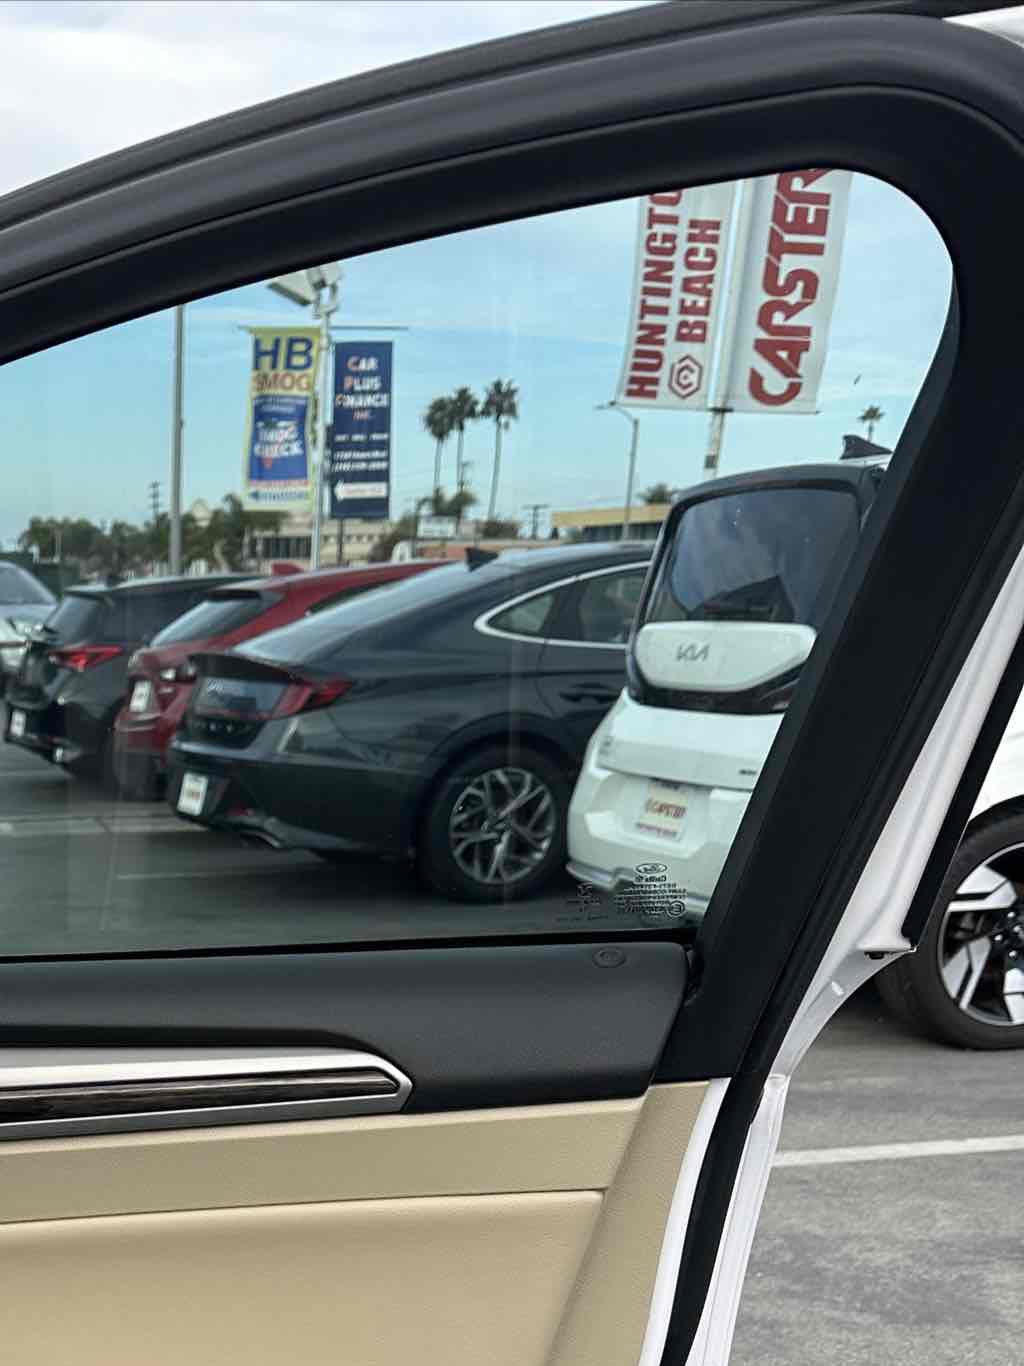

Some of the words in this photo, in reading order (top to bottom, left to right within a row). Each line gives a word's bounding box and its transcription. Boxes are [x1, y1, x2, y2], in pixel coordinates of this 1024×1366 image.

[624, 188, 683, 399] HUNTINGTO
[676, 218, 722, 344] BEACH
[254, 336, 313, 371] HB
